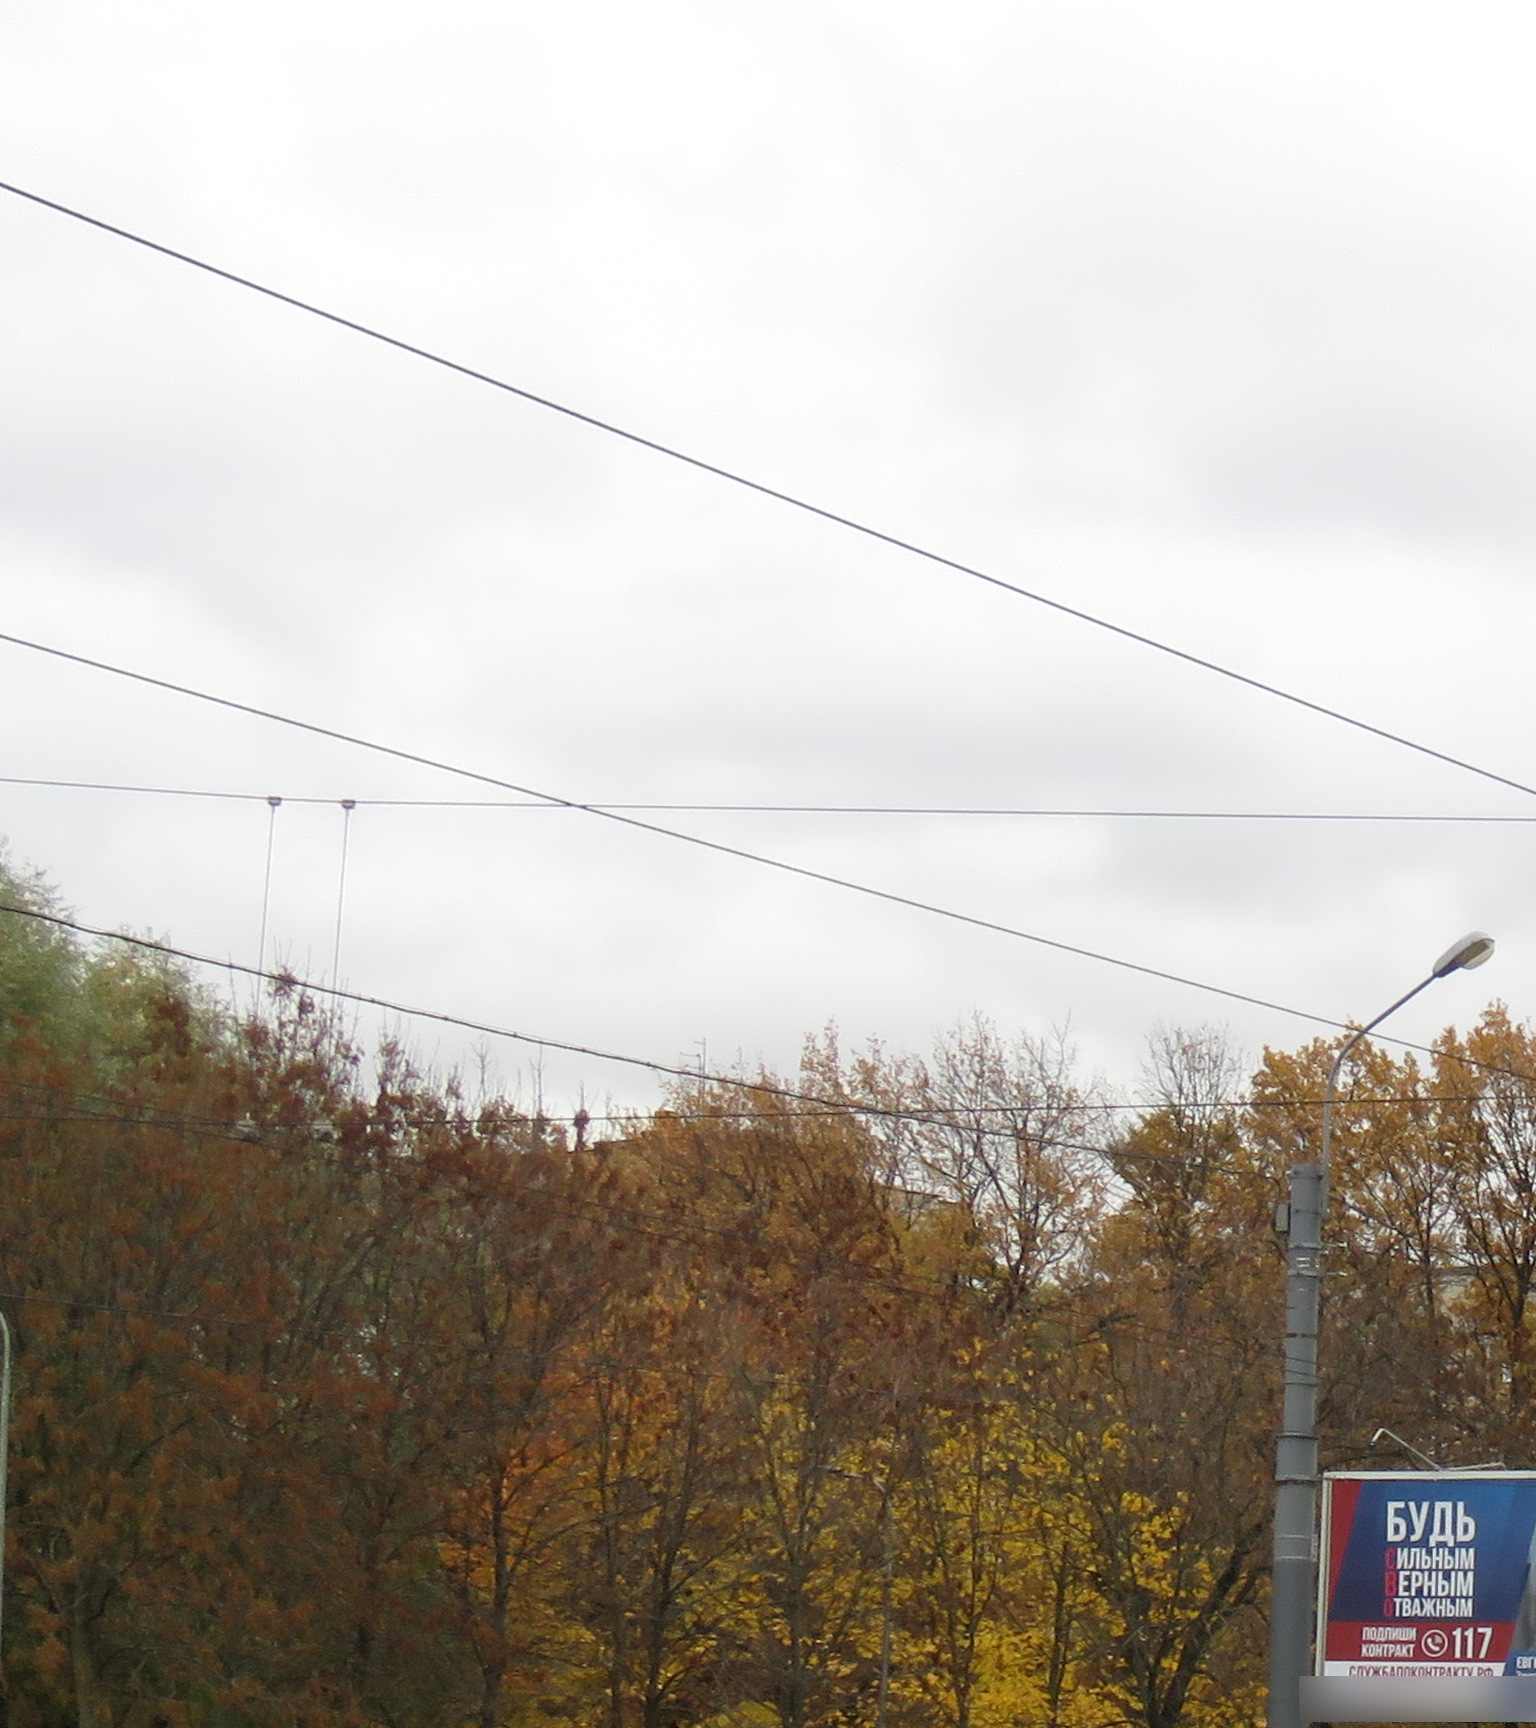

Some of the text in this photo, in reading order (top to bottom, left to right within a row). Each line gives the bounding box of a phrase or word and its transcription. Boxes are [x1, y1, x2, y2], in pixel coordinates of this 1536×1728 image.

[1386, 1501, 1476, 1547] БУДЬ
[1384, 1547, 1475, 1570] СИЛЬНЫМ
[1384, 1570, 1474, 1597] ВЕРНЫМ
[1383, 1597, 1473, 1618] ОТВАЖНЫМ
[1362, 1626, 1417, 1642] ПОДПИШИ
[1452, 1626, 1493, 1659] 117
[1361, 1643, 1415, 1659] КОНТРАКТ
[1349, 1665, 1494, 1677] СЛУЖБАПОКОНТРАКТУРФ
